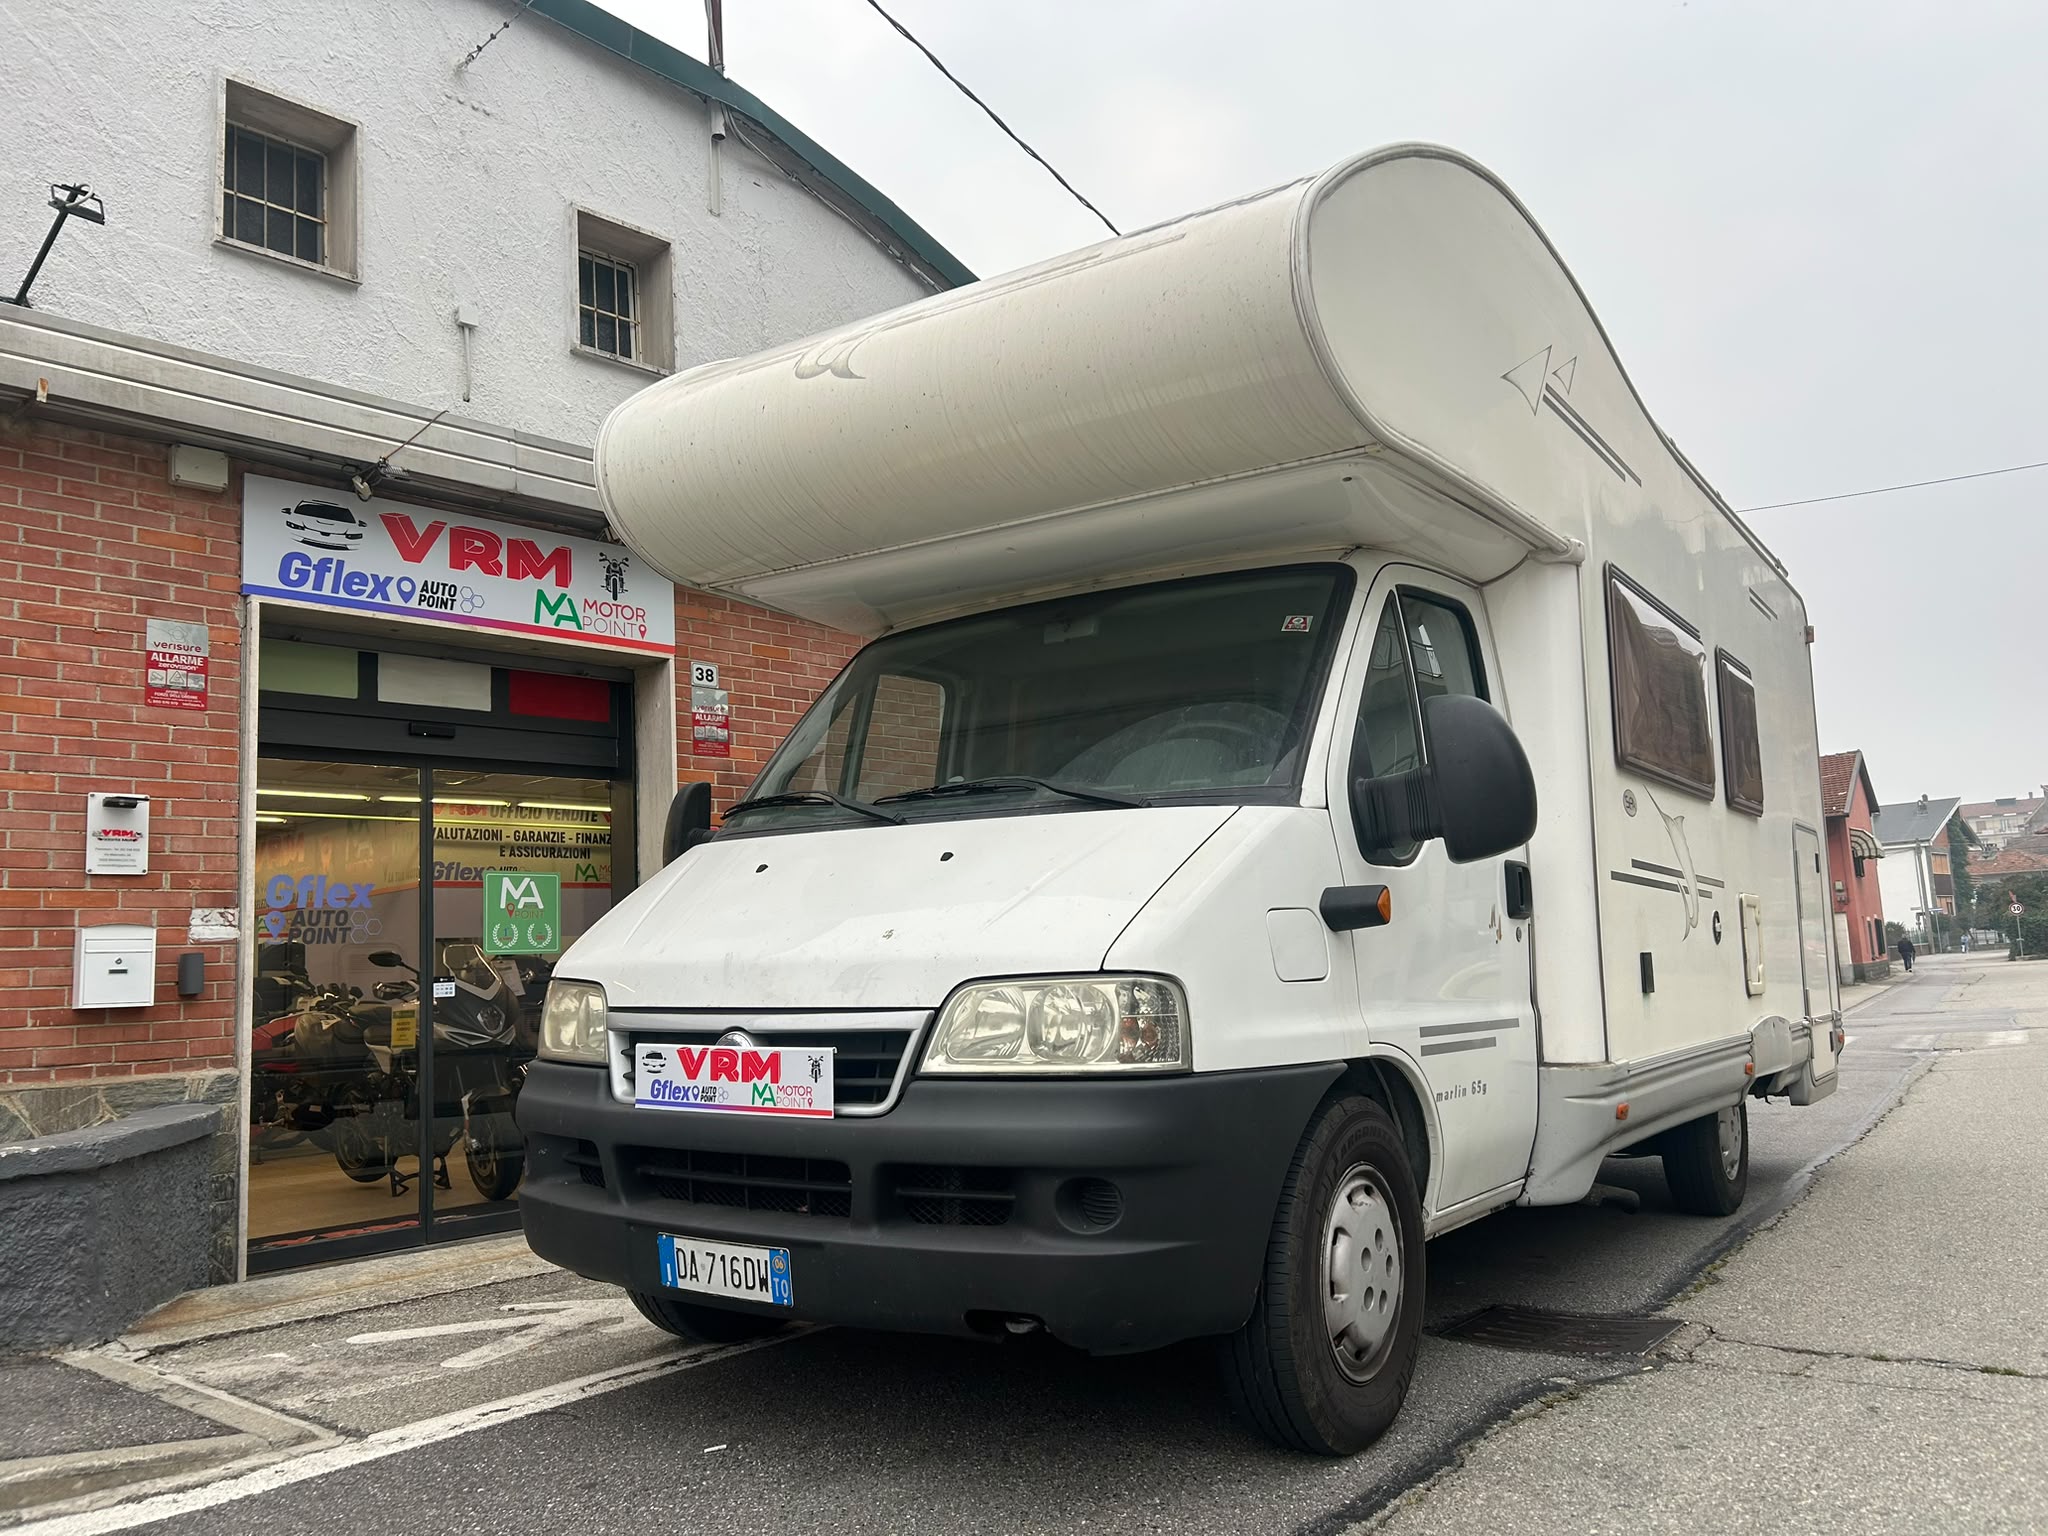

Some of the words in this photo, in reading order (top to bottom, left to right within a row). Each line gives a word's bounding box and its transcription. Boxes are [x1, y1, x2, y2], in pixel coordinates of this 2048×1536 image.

[378, 512, 572, 588] VRM
[277, 552, 394, 602] Gflex
[420, 579, 457, 598] AUTO
[418, 593, 457, 612] POINT
[534, 589, 583, 631] MA
[584, 598, 646, 624] MOTOR
[583, 615, 637, 637] POINT
[153, 641, 202, 653] verisure
[151, 652, 204, 667] ALLARME
[695, 667, 714, 683] 38
[549, 808, 598, 823] VENDITE
[101, 829, 134, 838] VRM
[513, 830, 566, 844] GARANZIE
[499, 846, 506, 857] E
[509, 846, 591, 859] ASSICURAZIONI
[266, 874, 376, 909] Gflex
[500, 877, 544, 909] MA
[291, 910, 349, 927] AUTO
[515, 910, 544, 920] POINT
[287, 927, 351, 945] POINT
[676, 1047, 781, 1084] VRM
[650, 1079, 691, 1101] Gflex
[700, 1094, 717, 1103] POINT
[701, 1086, 717, 1095] AUTO
[752, 1082, 777, 1106] MA
[777, 1085, 813, 1097] MOTOR
[1436, 1084, 1466, 1102] marlin
[776, 1097, 807, 1108] POINT
[773, 1277, 789, 1298] TO
